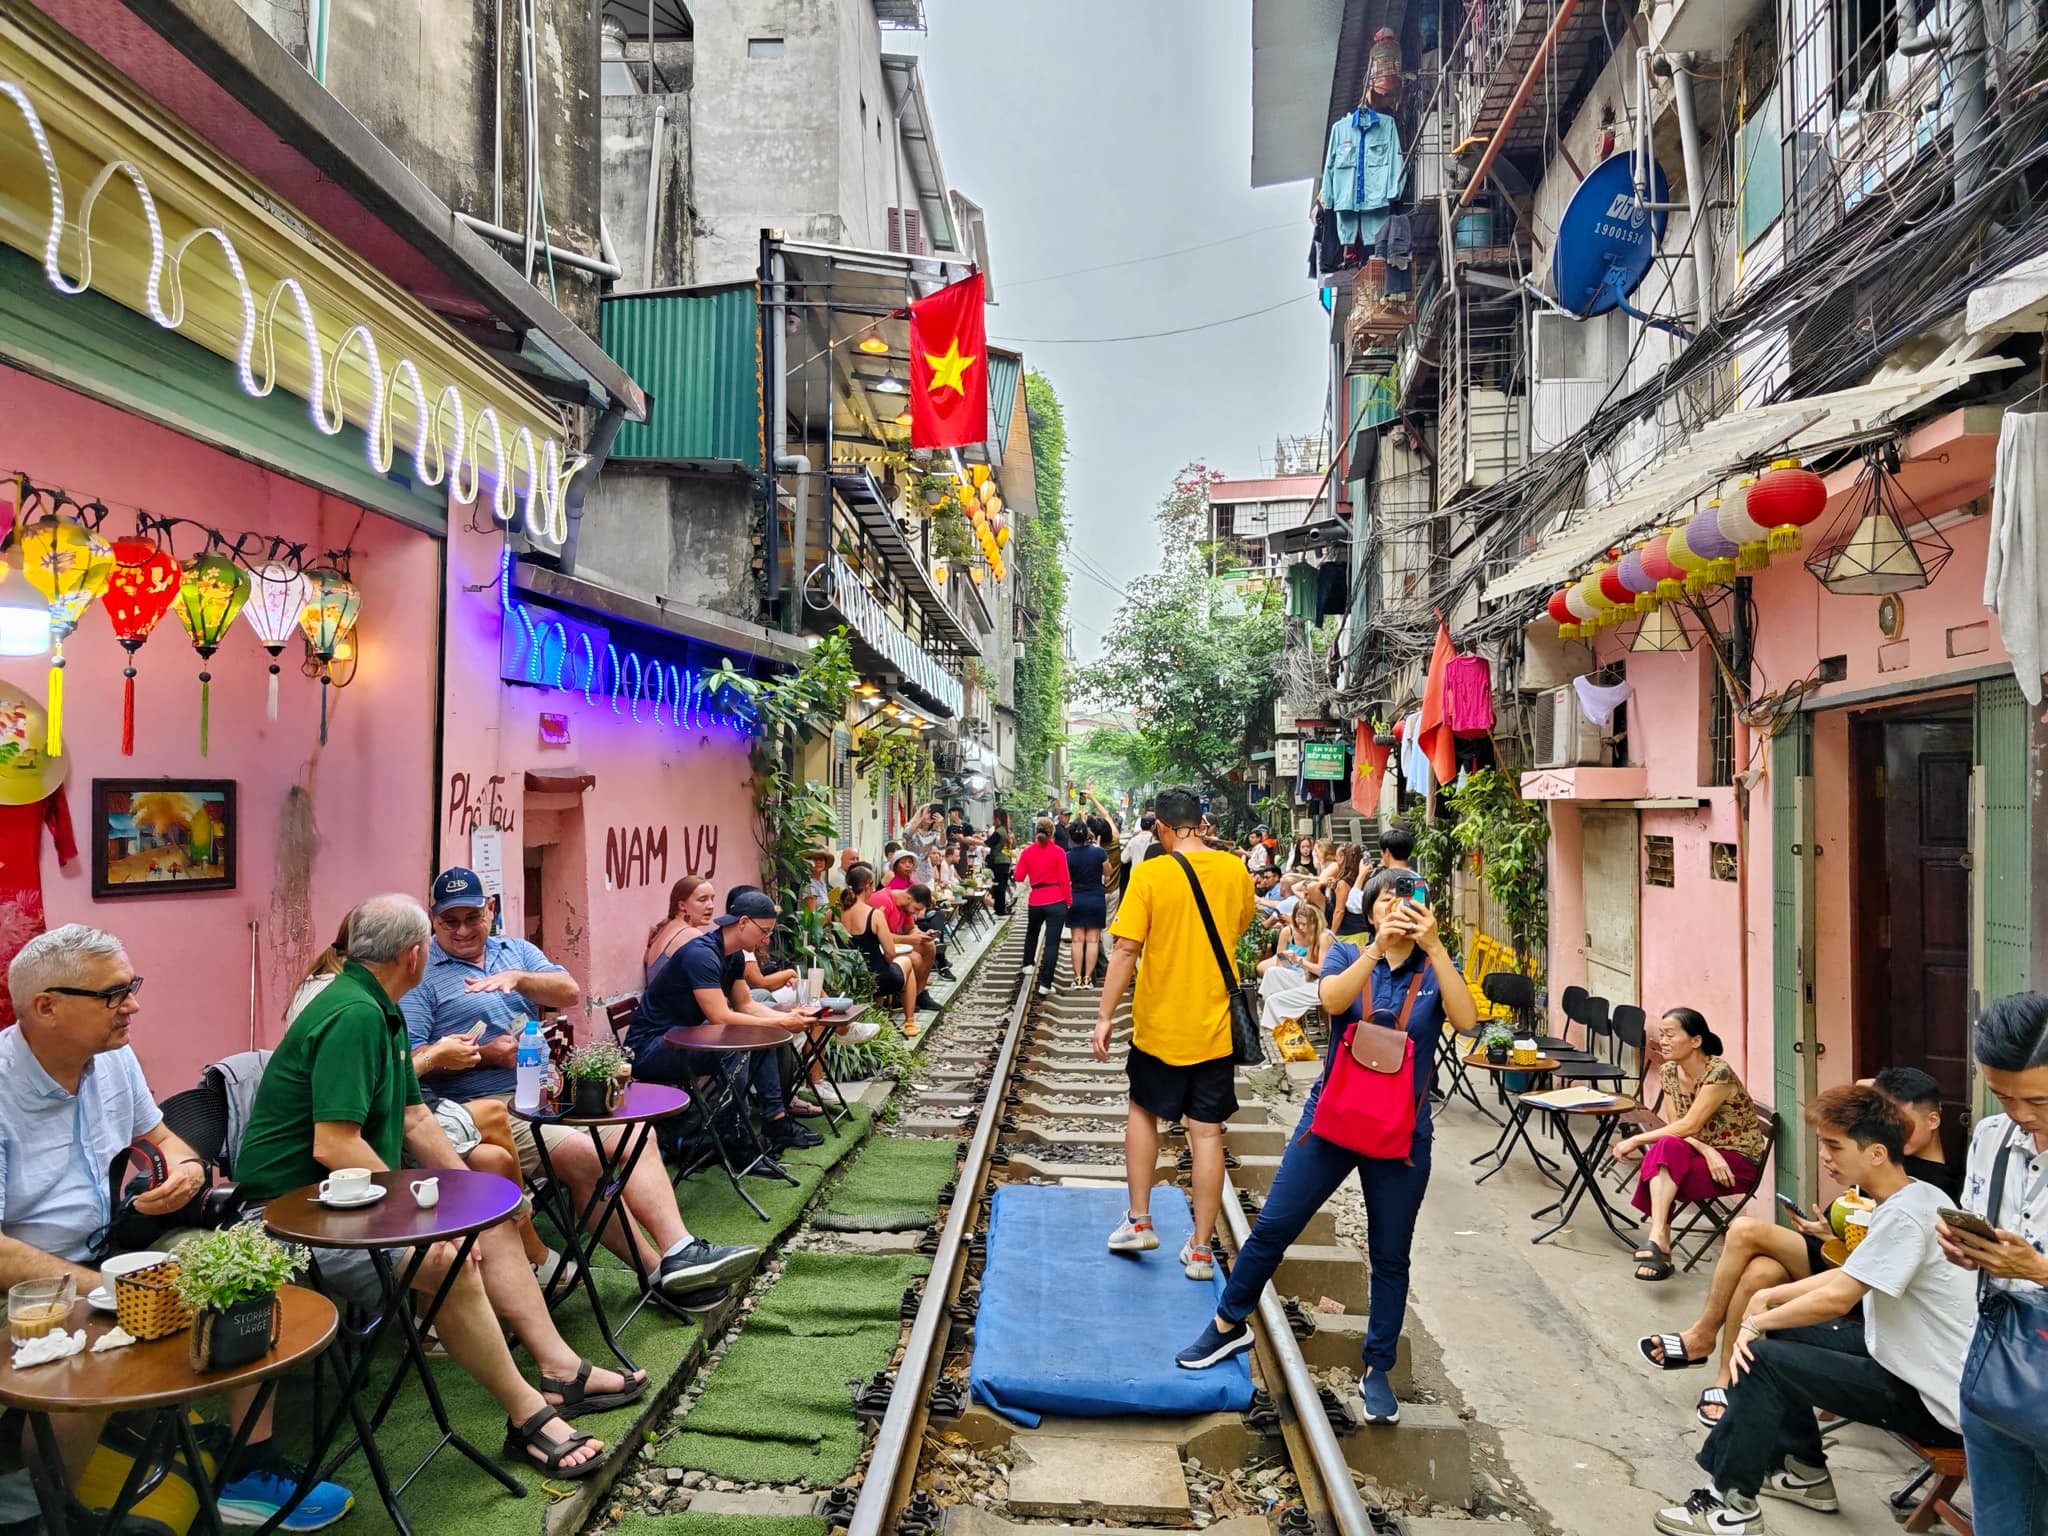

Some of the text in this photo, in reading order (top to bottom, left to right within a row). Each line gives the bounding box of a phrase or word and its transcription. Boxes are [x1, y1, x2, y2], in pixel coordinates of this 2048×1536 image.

[1594, 222, 1644, 245] 19001530
[606, 824, 718, 889] NAM VY
[447, 879, 466, 888] CHS
[233, 1305, 272, 1325] STORAGE
[240, 1319, 267, 1336] LARGE
